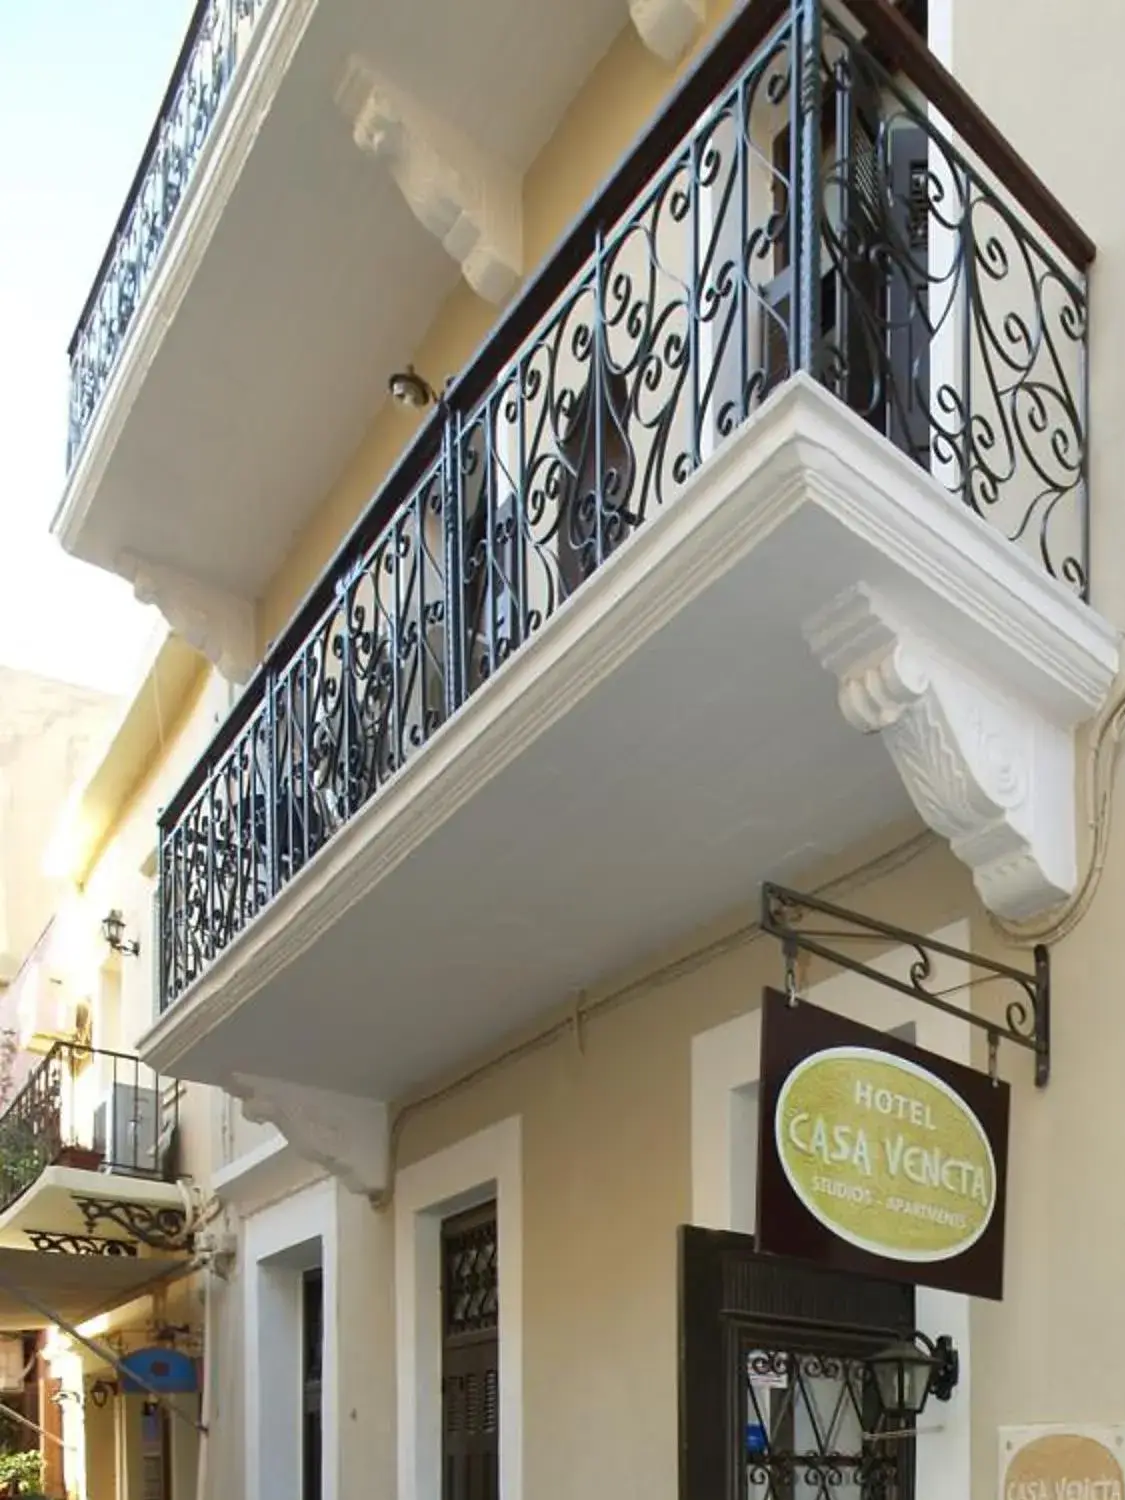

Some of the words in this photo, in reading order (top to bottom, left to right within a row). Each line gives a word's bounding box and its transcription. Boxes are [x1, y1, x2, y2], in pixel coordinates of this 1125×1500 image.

[855, 1080, 937, 1131] HOTEL
[789, 1112, 872, 1176] CASA
[884, 1134, 988, 1208] VENETA
[813, 1176, 872, 1205] STUDIOS
